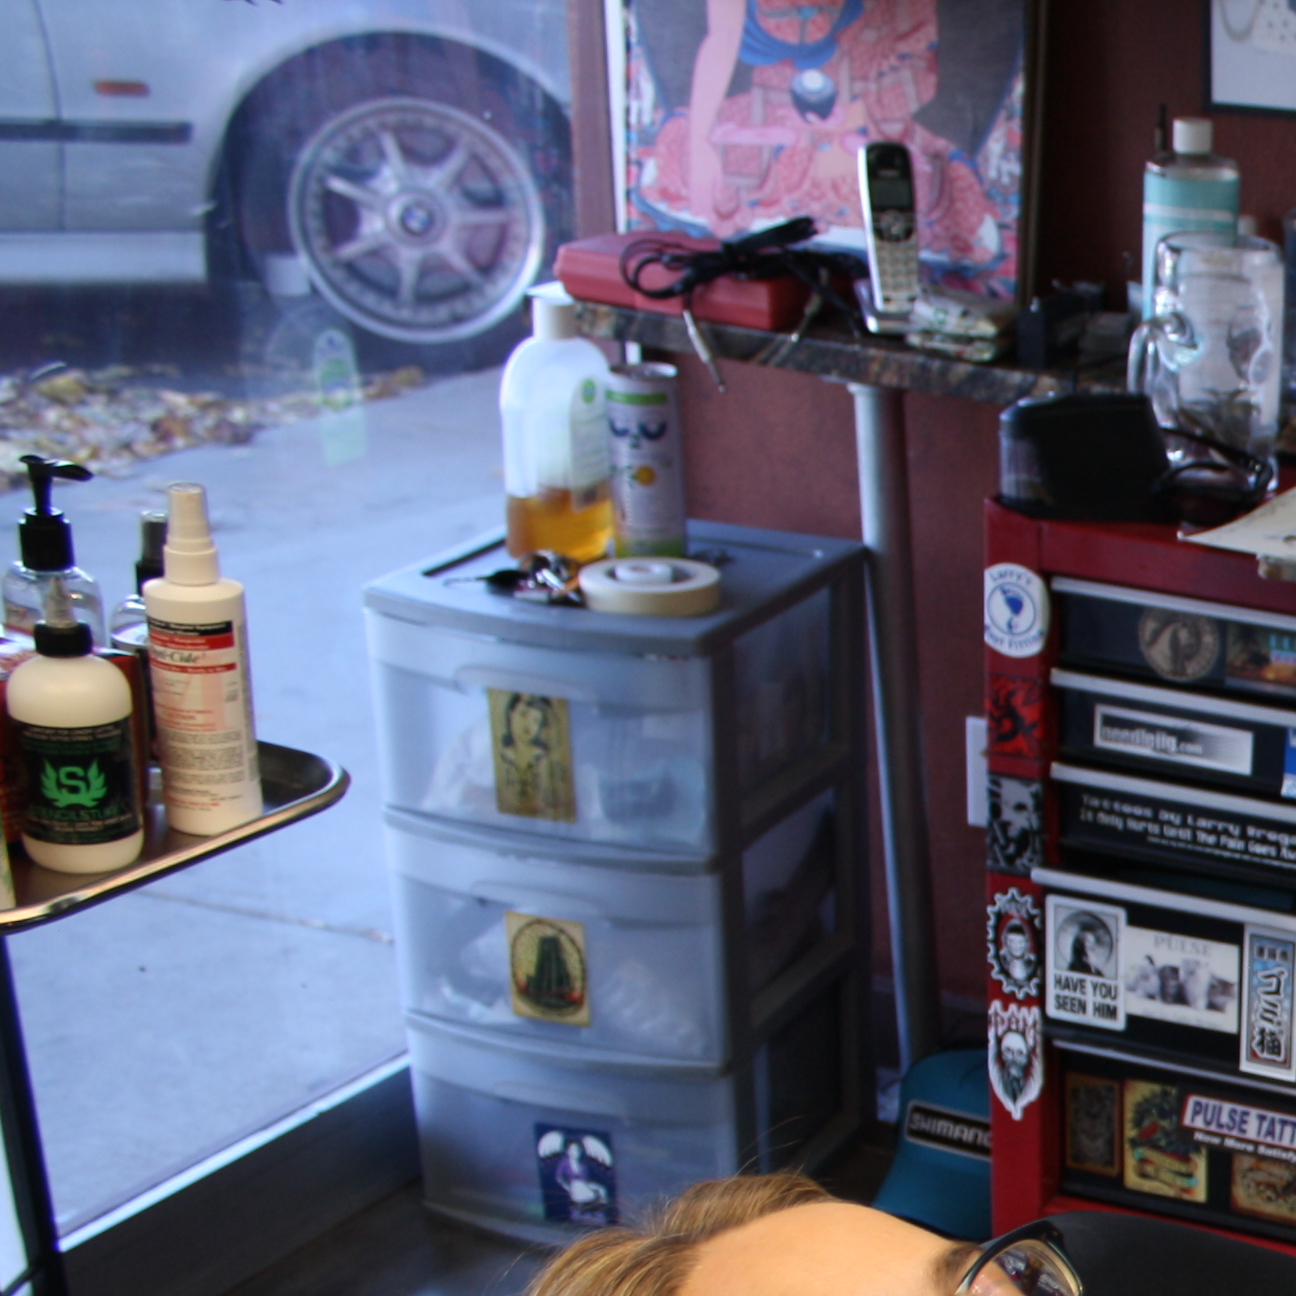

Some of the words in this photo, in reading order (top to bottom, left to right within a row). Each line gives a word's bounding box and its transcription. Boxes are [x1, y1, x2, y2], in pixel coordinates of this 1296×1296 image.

[1187, 814, 1242, 838] Larry
[1153, 934, 1210, 955] PULSE
[1054, 974, 1087, 996] HAVE
[1091, 980, 1118, 1001] YOU
[1054, 994, 1087, 1016] SEEN
[1093, 1001, 1118, 1021] HIM
[1190, 1101, 1248, 1135] PULSE
[1193, 1131, 1221, 1146] Now
[1223, 1137, 1254, 1152] More
